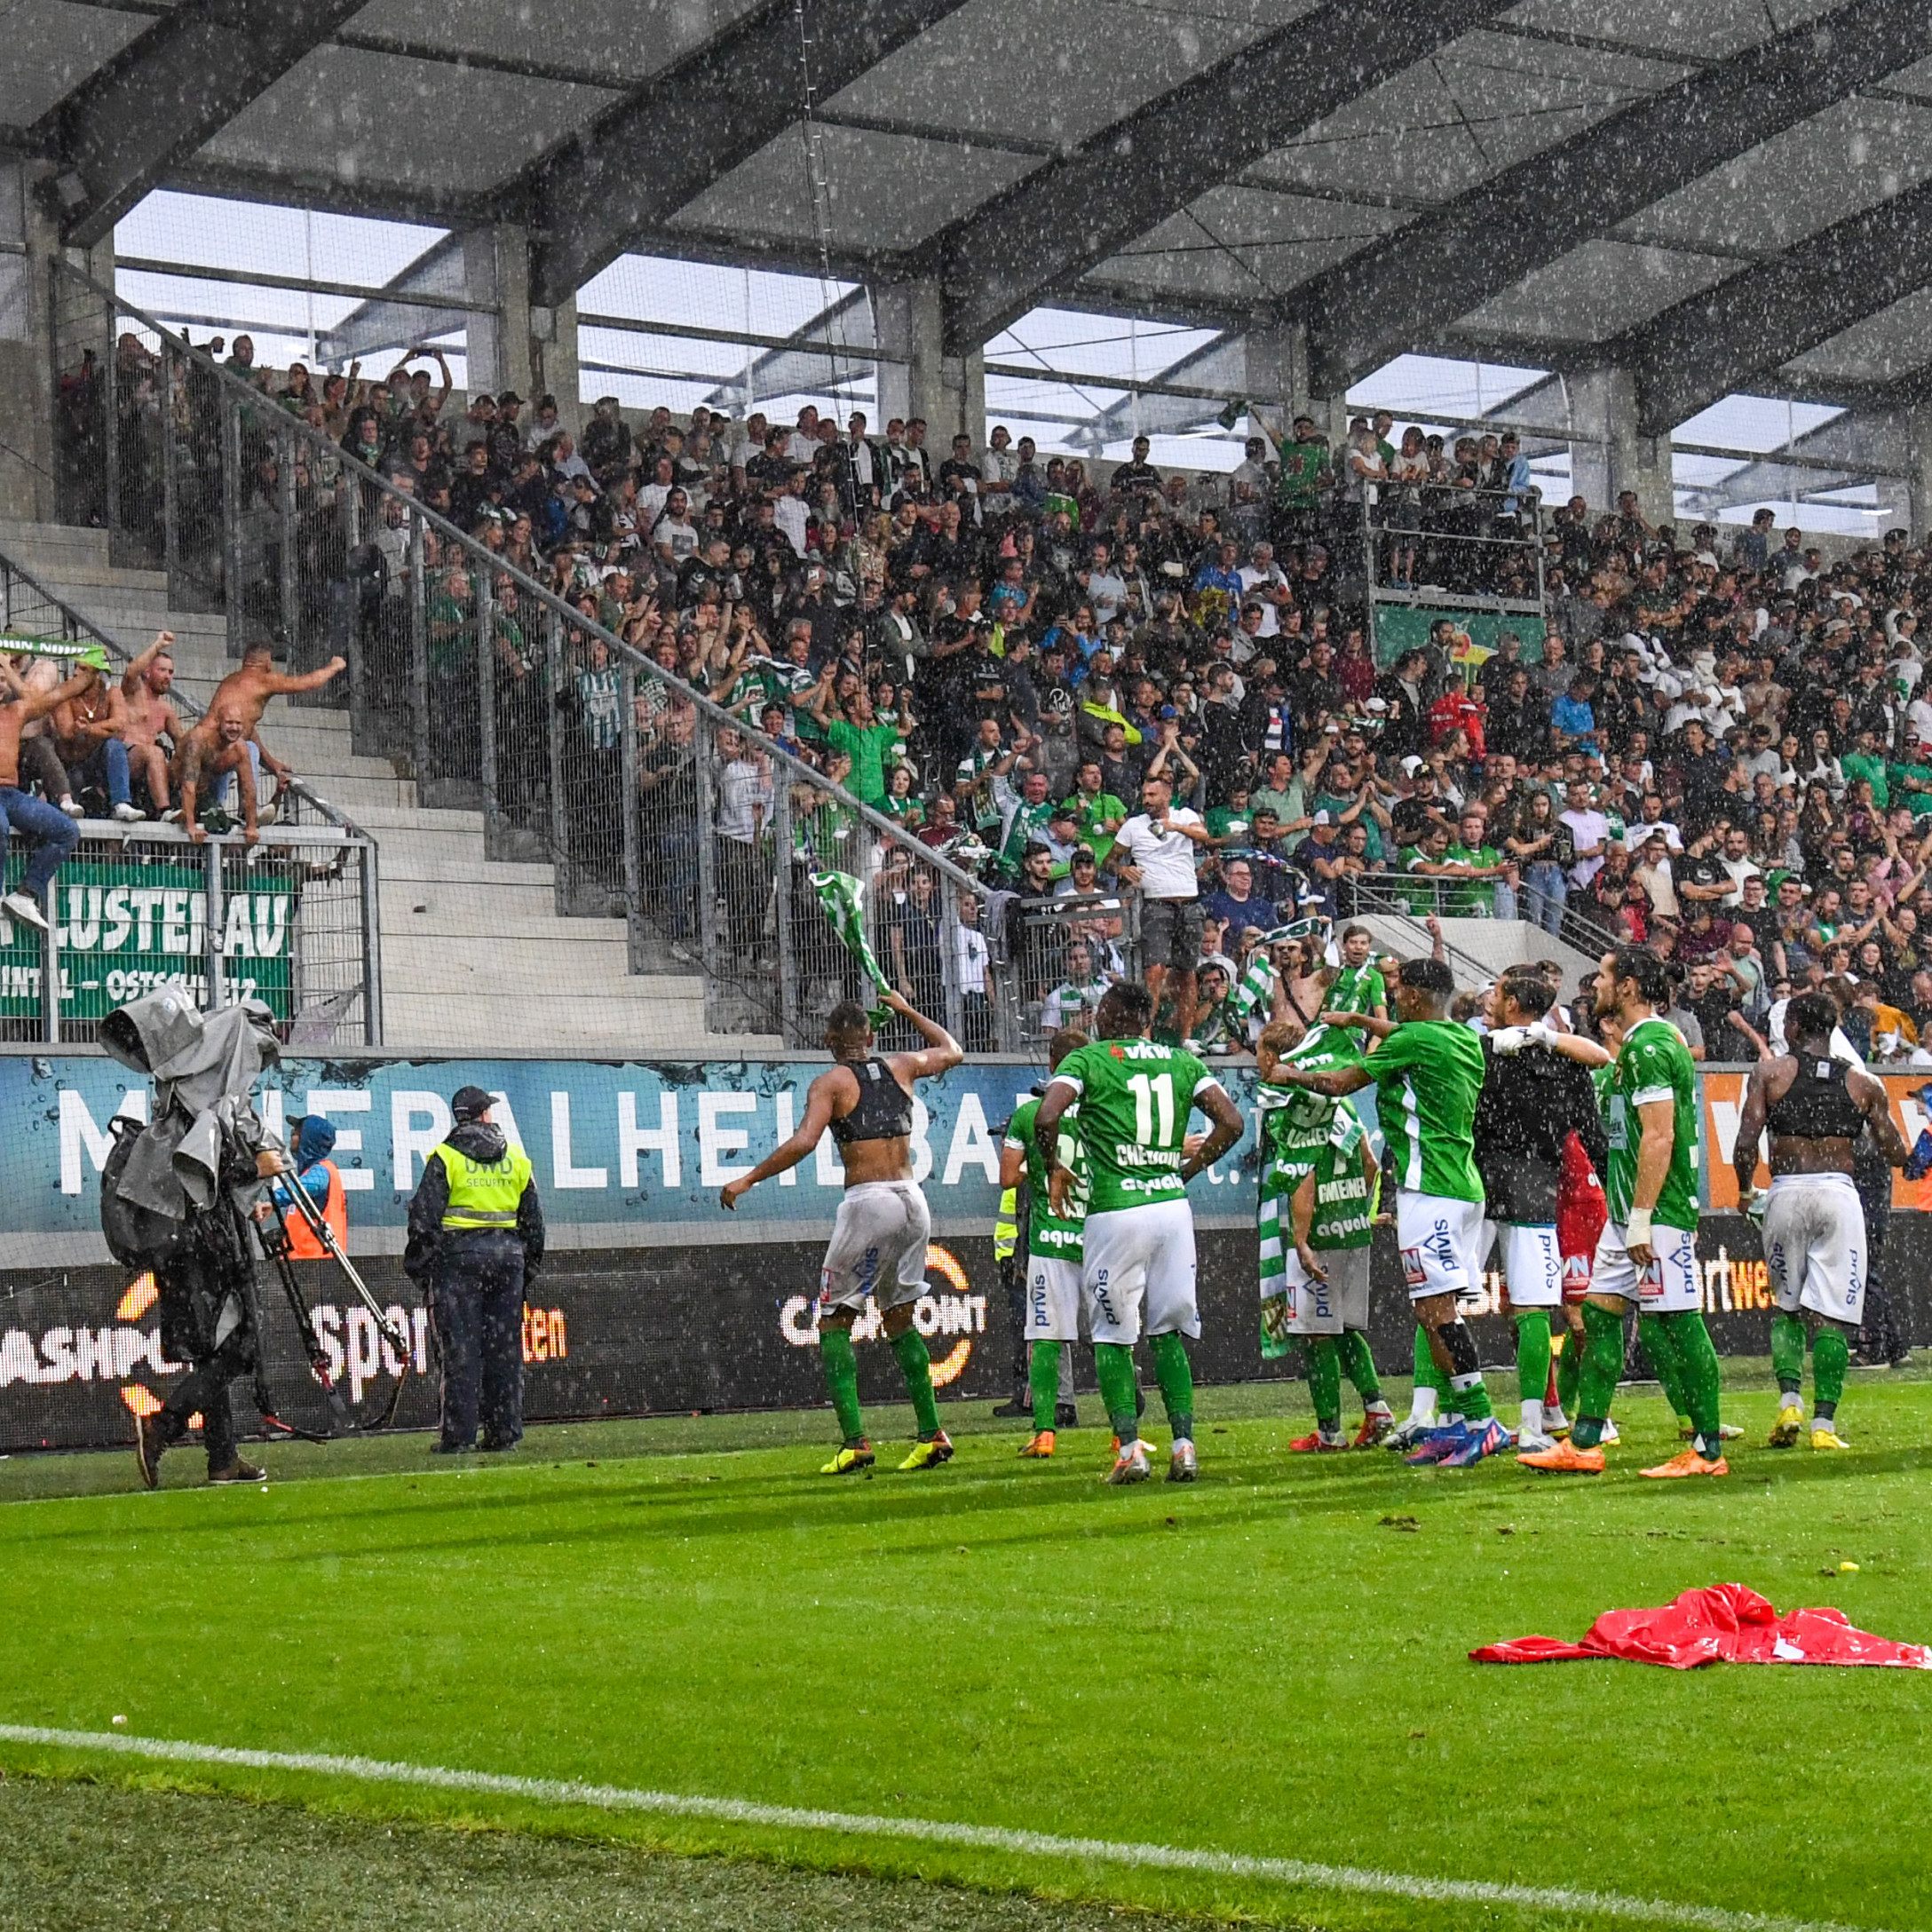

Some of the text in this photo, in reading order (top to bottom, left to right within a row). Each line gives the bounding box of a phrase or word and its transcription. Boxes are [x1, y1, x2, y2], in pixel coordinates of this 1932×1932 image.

[56, 884, 289, 956] USTEAU
[1127, 1073, 1174, 1147] 11
[466, 1178, 513, 1188] SECURITY
[1434, 1219, 1461, 1272] privis
[1034, 1274, 1050, 1326] privis
[1098, 1269, 1120, 1326] privis
